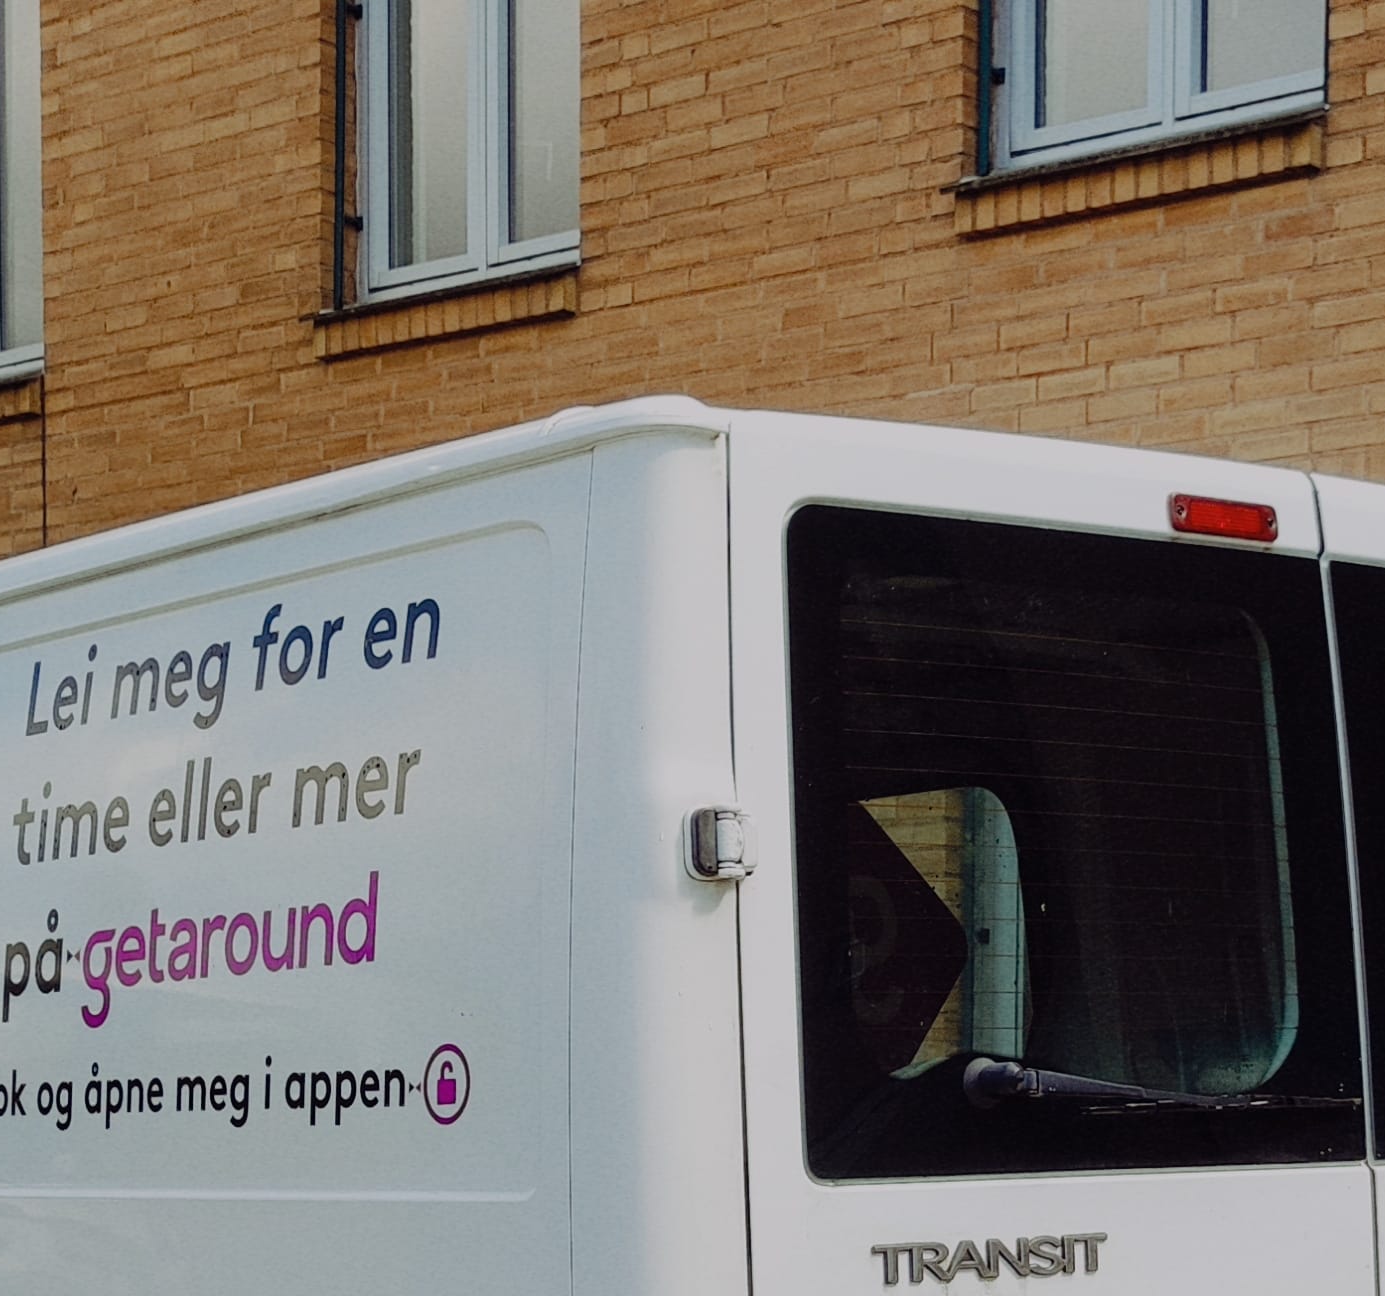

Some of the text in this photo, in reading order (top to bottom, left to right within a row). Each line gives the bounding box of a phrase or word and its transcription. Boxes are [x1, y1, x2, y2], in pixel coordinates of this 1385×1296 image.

[25, 598, 441, 736] Lei meg for en
[13, 749, 421, 865] time eller mer
[2, 870, 380, 1029] på getaround
[37, 1081, 73, 1131] og
[84, 1062, 164, 1128] åpne
[176, 1072, 250, 1127] meg
[264, 1055, 273, 1110] i
[285, 1068, 406, 1126] appen
[871, 1232, 1108, 1285] TRANSIT
